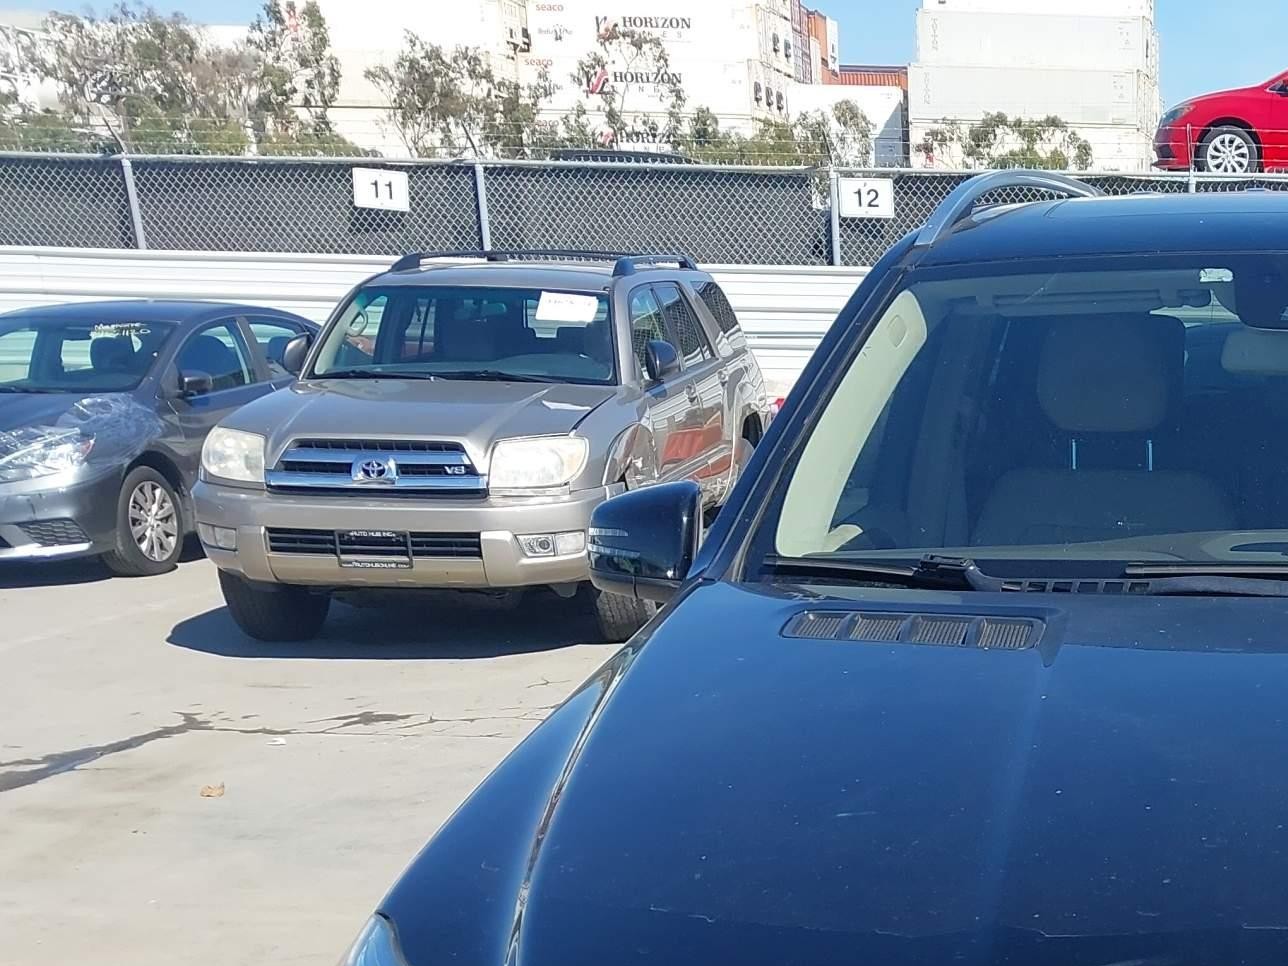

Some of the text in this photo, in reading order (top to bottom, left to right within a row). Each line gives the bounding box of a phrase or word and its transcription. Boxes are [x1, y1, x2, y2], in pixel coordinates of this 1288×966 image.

[535, 3, 564, 12] seaco
[622, 16, 691, 29] HORIZON
[524, 57, 553, 67] seaco
[613, 71, 682, 84] HORIZON
[370, 179, 393, 200] 11
[853, 188, 879, 208] 12
[444, 465, 465, 475] V8
